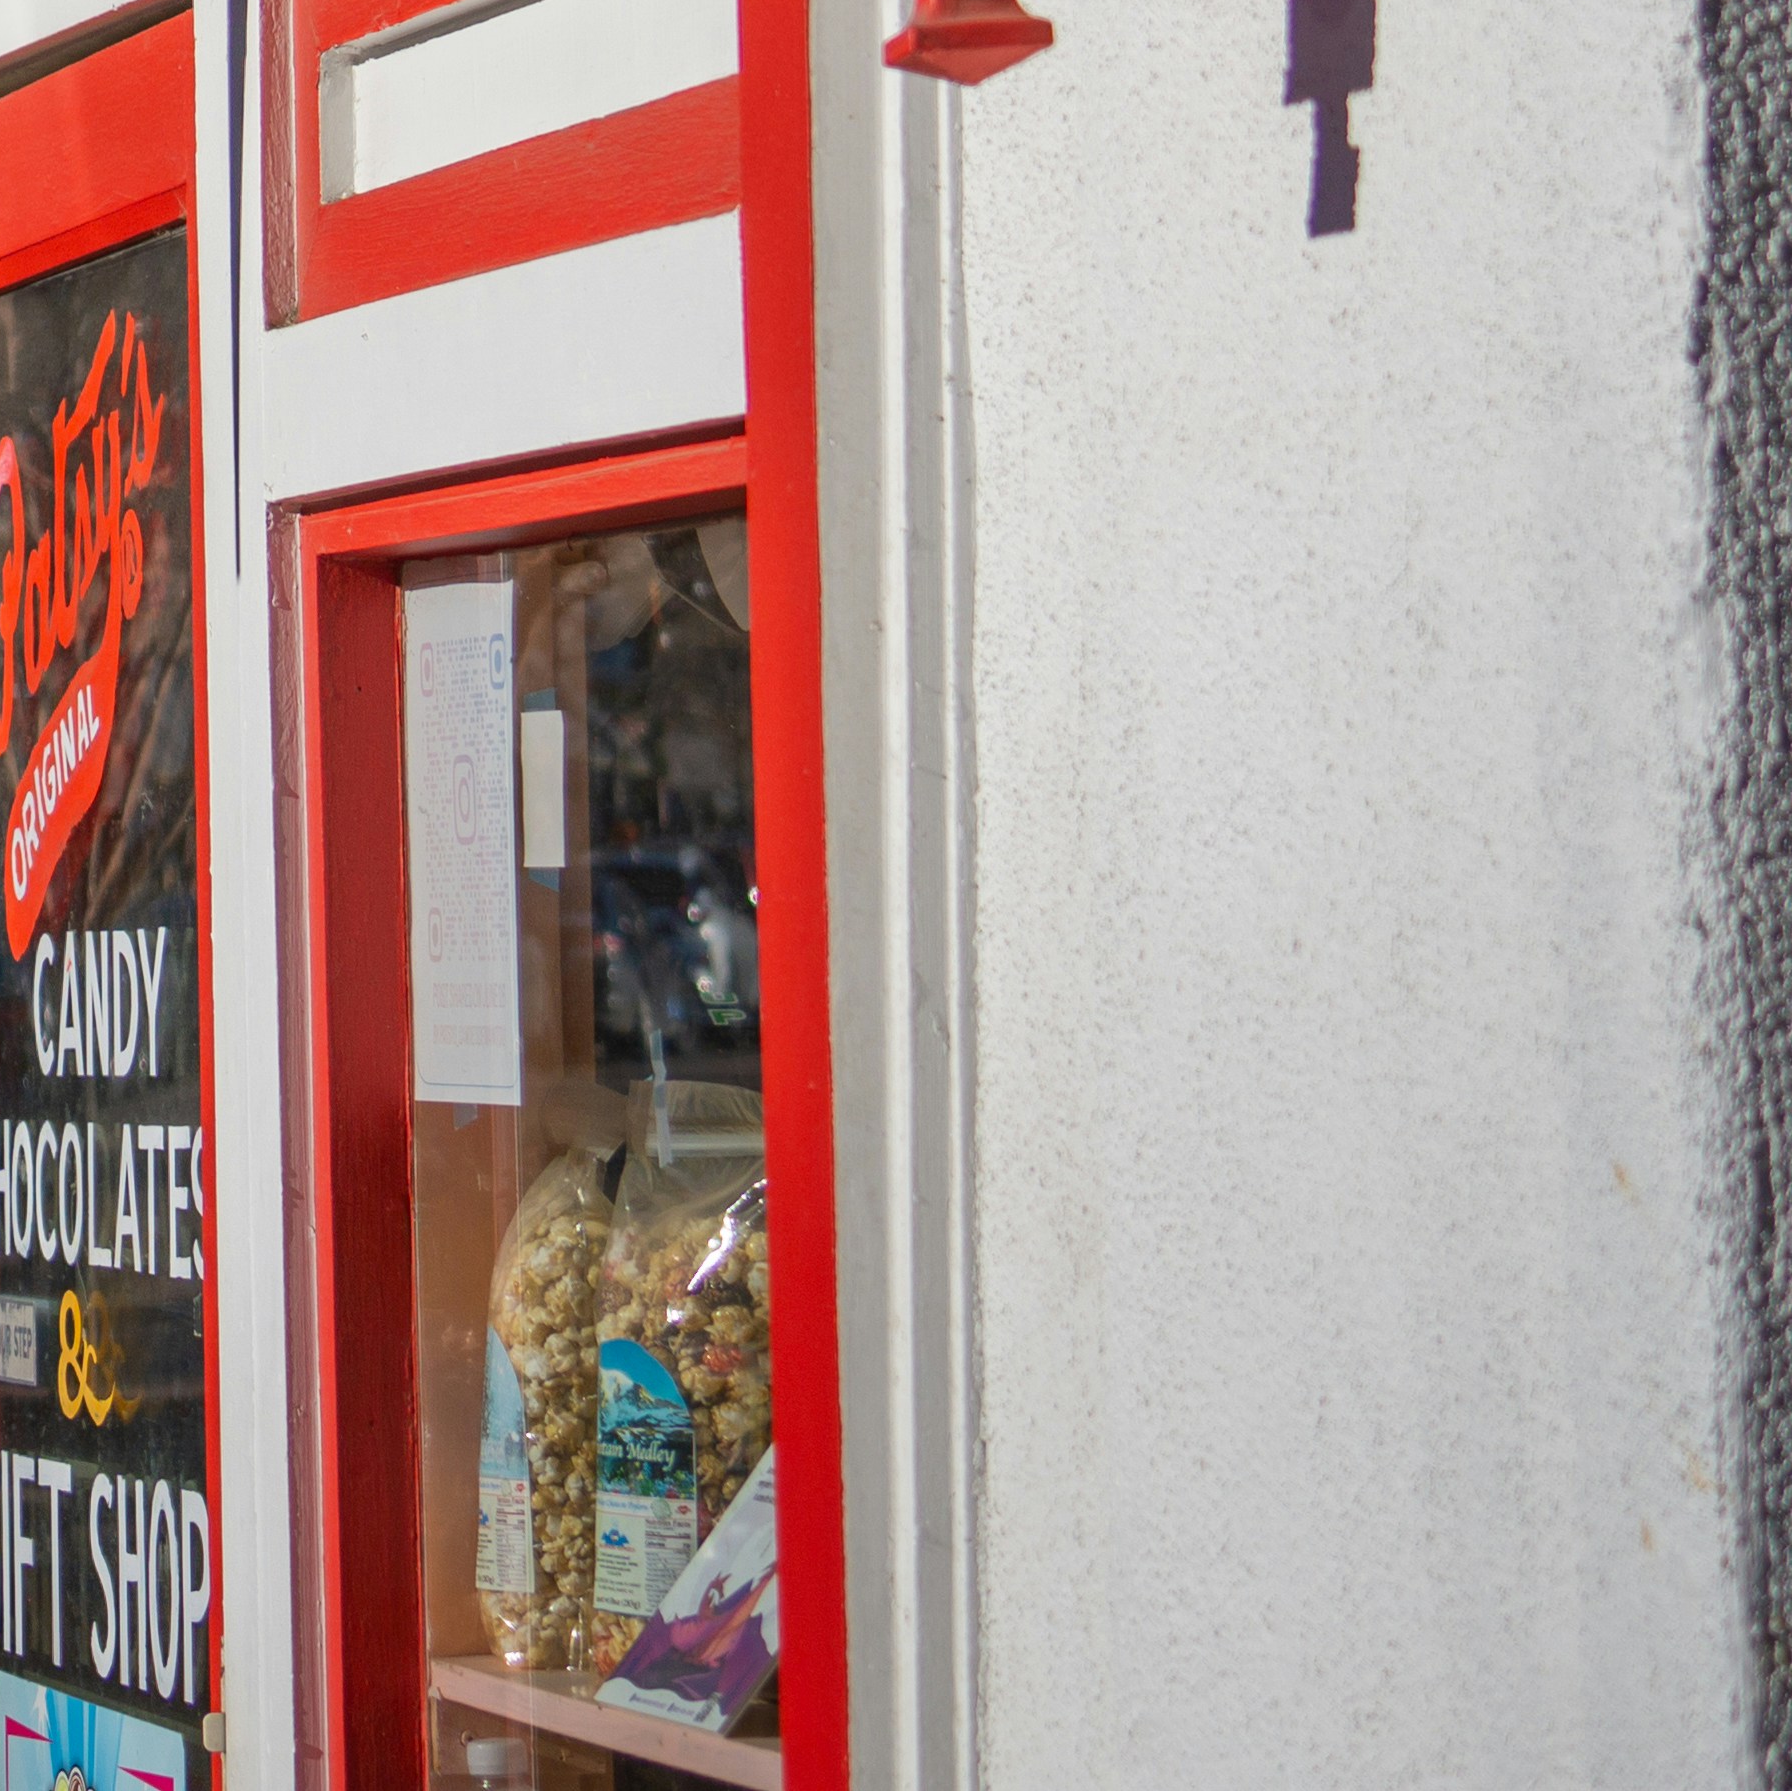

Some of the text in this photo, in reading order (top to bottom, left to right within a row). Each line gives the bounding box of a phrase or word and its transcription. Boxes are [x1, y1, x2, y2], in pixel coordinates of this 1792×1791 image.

[11, 683, 101, 902] ORIGINAL
[33, 926, 167, 1078] CANDY
[14, 1325, 33, 1360] STEP
[57, 1289, 115, 1427] &
[626, 1440, 676, 1472] Medley
[89, 1471, 212, 1706] SHOP
